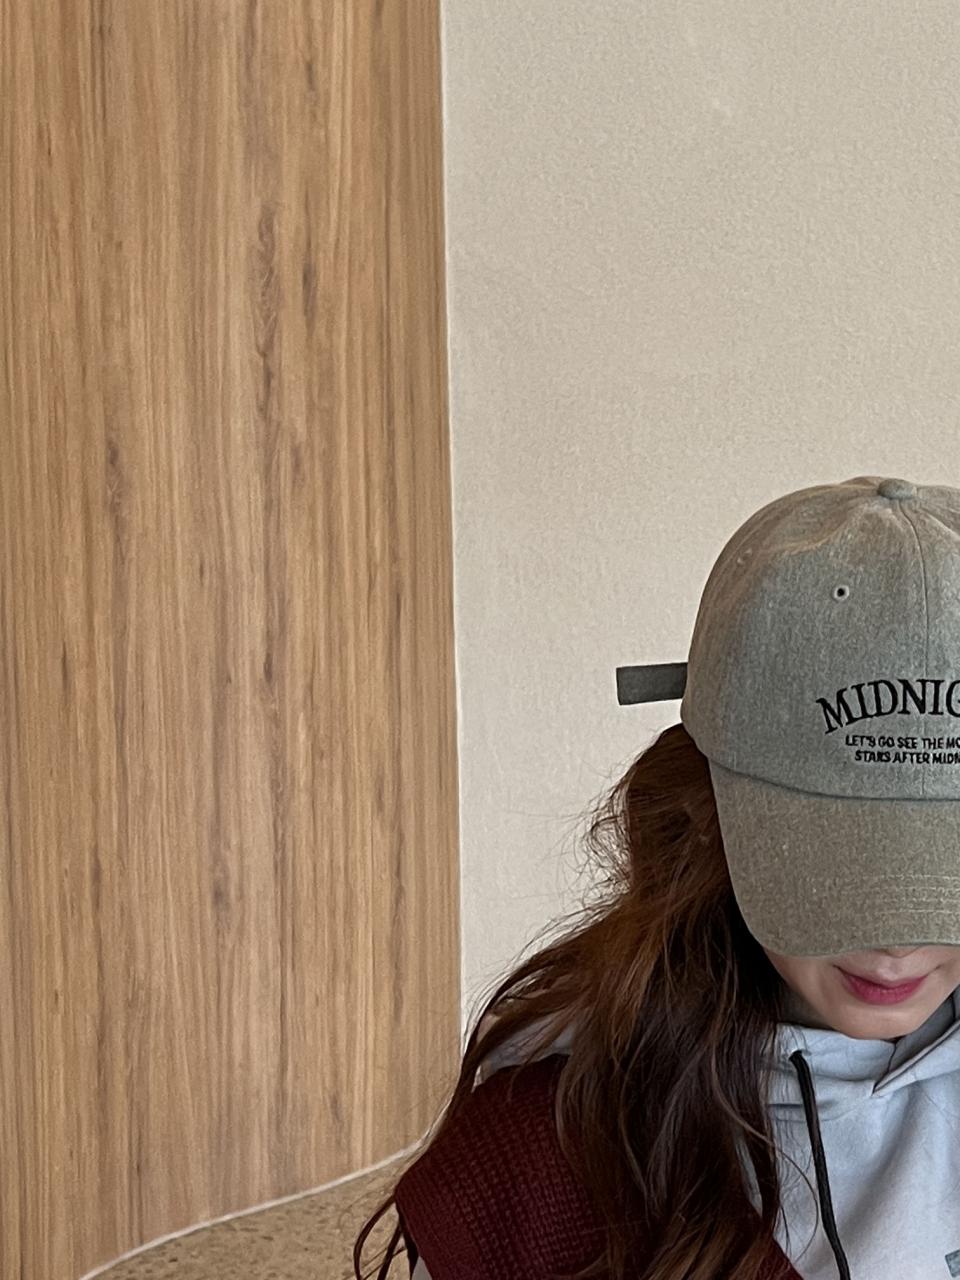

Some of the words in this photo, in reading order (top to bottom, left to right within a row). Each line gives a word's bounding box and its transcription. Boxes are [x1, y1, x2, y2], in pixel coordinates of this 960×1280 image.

[845, 735, 876, 747] LET'S
[878, 736, 895, 748] GO
[897, 737, 918, 749] SEE
[922, 737, 944, 749] THE
[854, 750, 891, 763] STARS
[893, 751, 930, 764] AFTER
